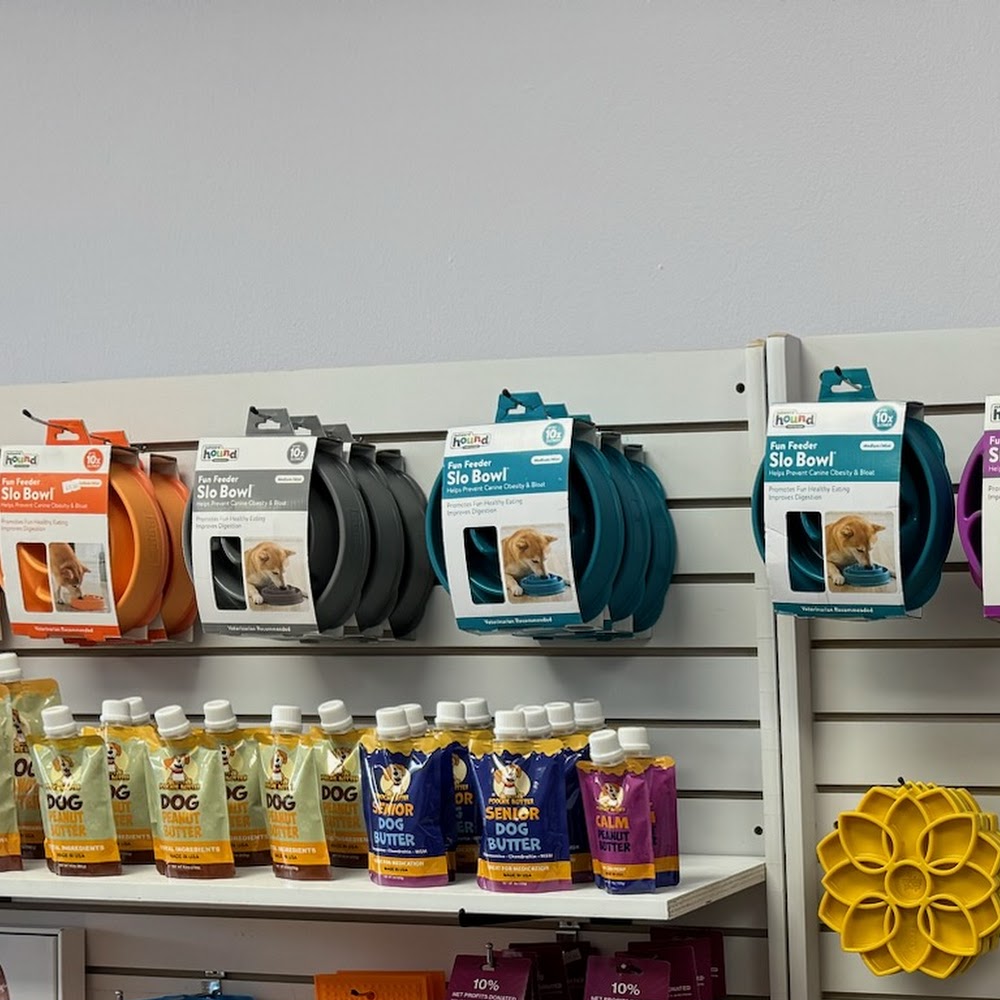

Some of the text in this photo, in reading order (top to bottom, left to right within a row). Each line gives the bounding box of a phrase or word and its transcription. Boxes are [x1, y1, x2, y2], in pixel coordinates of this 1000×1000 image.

[776, 414, 814, 426] hound
[876, 412, 893, 423] 10x
[546, 429, 561, 439] 10x
[453, 436, 488, 447] hound
[770, 441, 818, 450] Fun Feeder
[204, 450, 237, 459] hound
[290, 448, 305, 457] 10x
[769, 451, 834, 468] Slo Bowl
[214, 475, 239, 483] Feeder
[447, 467, 507, 485] Slo Bowl
[2, 487, 54, 500] Slo Bowl
[197, 484, 252, 498] Slo Bowl
[322, 785, 358, 801] DOG
[47, 794, 83, 811] DOG
[161, 794, 199, 811] DOG
[266, 793, 296, 810] DOG
[372, 803, 414, 816] SENIOR
[485, 806, 539, 821] SENIOR
[378, 817, 404, 830] DOG
[596, 815, 629, 829] CALM
[496, 822, 528, 836] DOG
[374, 832, 415, 846] BUTTER
[598, 831, 630, 841] PEANUT
[488, 837, 542, 851] BUTTER
[599, 842, 631, 853] BUTTER
[473, 978, 500, 991] 10%
[611, 982, 640, 996] 10%
